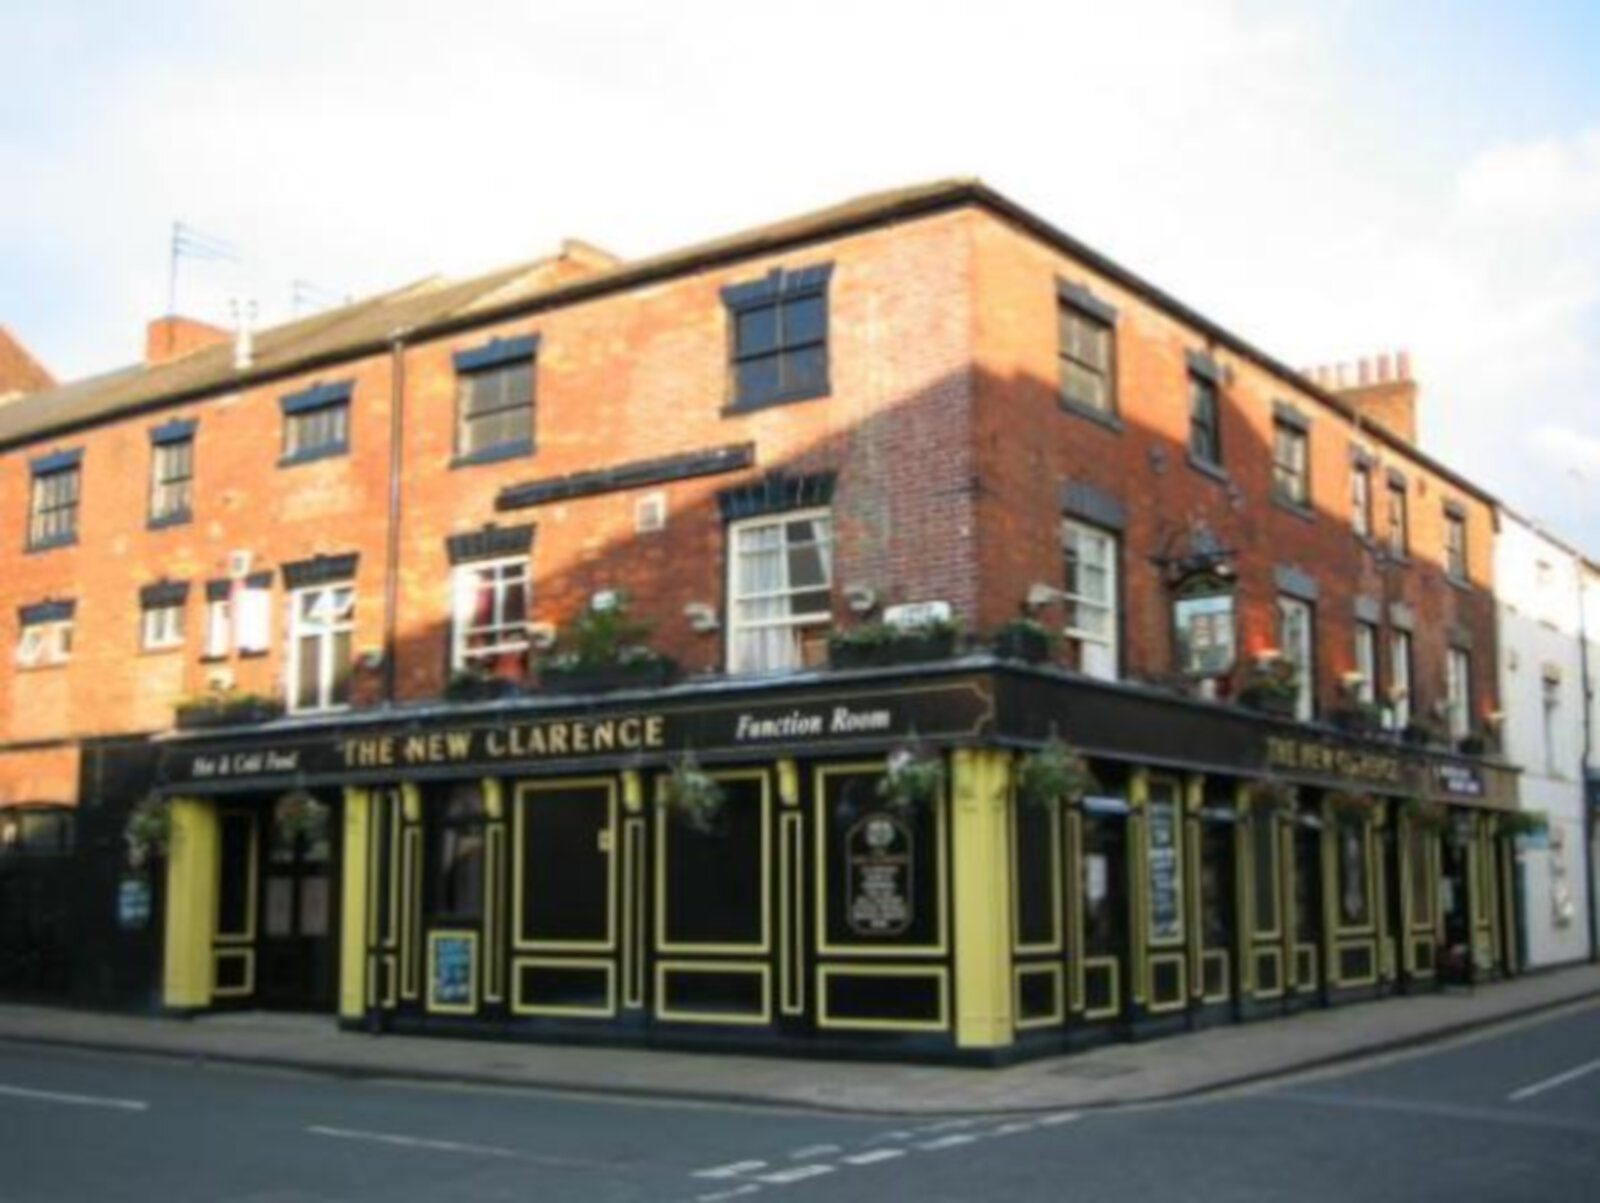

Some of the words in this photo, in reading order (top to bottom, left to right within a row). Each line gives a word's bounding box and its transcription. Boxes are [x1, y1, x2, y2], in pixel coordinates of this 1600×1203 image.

[341, 736, 395, 767] THE
[403, 730, 473, 763] NEW
[485, 715, 665, 757] CLARENCE
[735, 711, 822, 740] Function
[831, 706, 891, 733] Room
